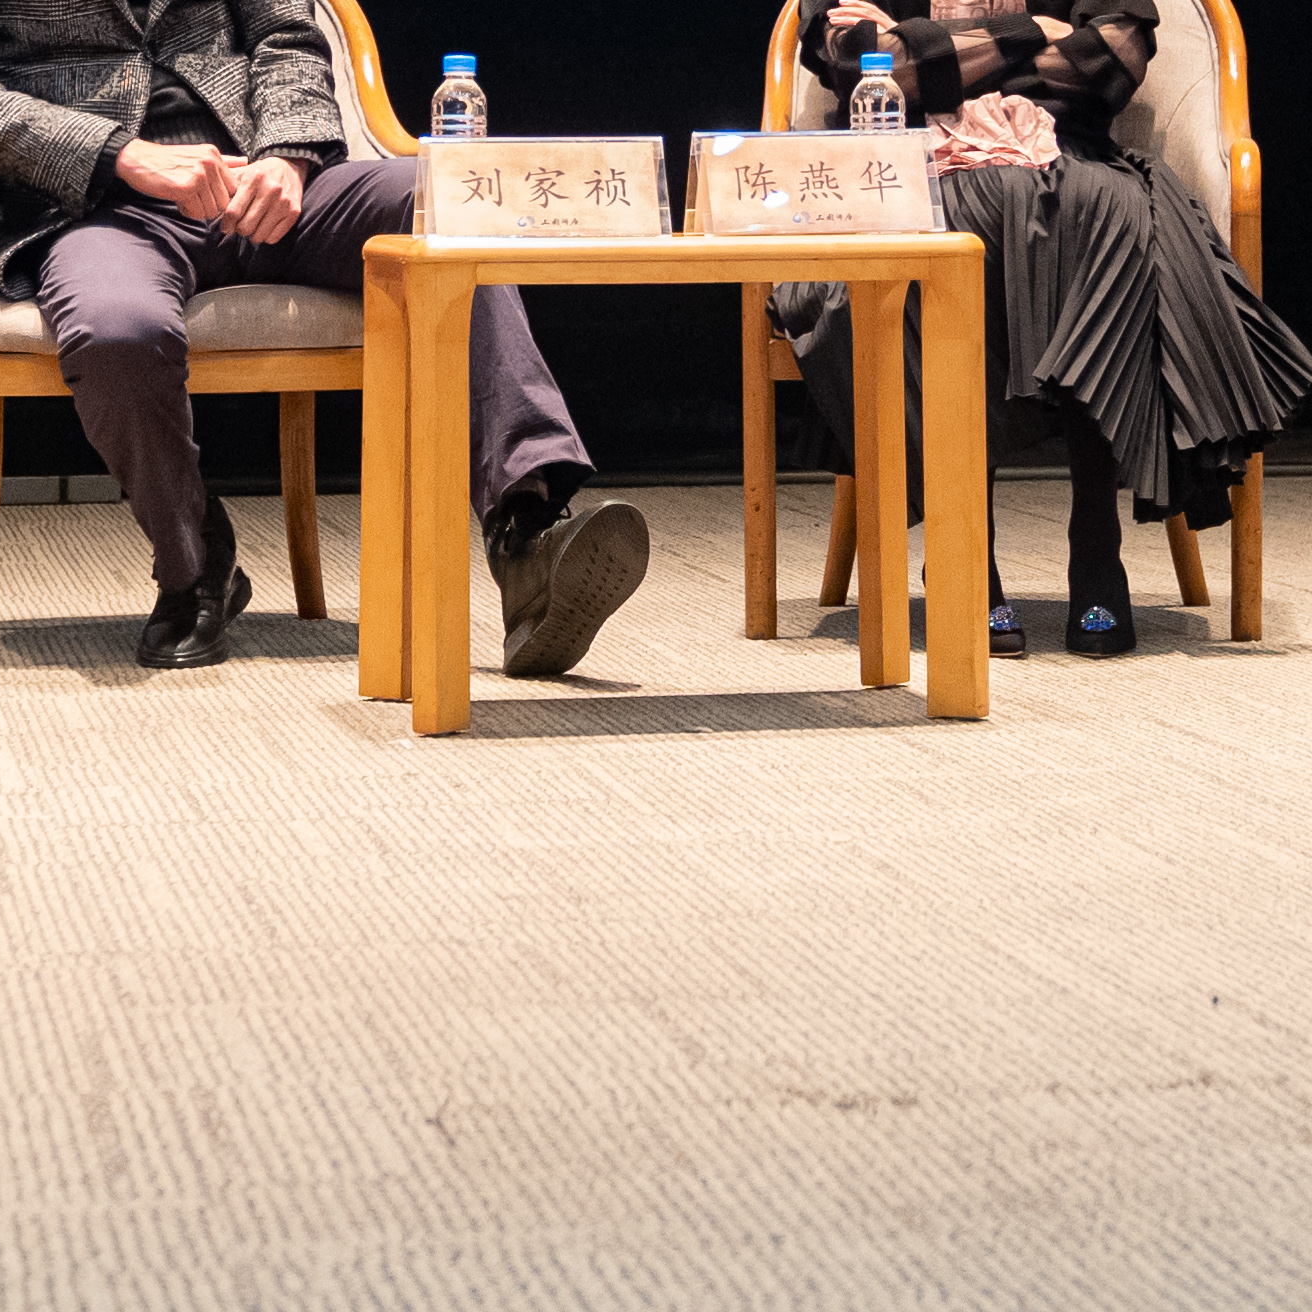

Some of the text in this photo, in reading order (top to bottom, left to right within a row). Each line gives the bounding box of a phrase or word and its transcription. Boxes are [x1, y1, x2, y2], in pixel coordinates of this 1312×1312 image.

[461, 167, 633, 209] 刘家祯
[733, 160, 904, 202] 陈燕华
